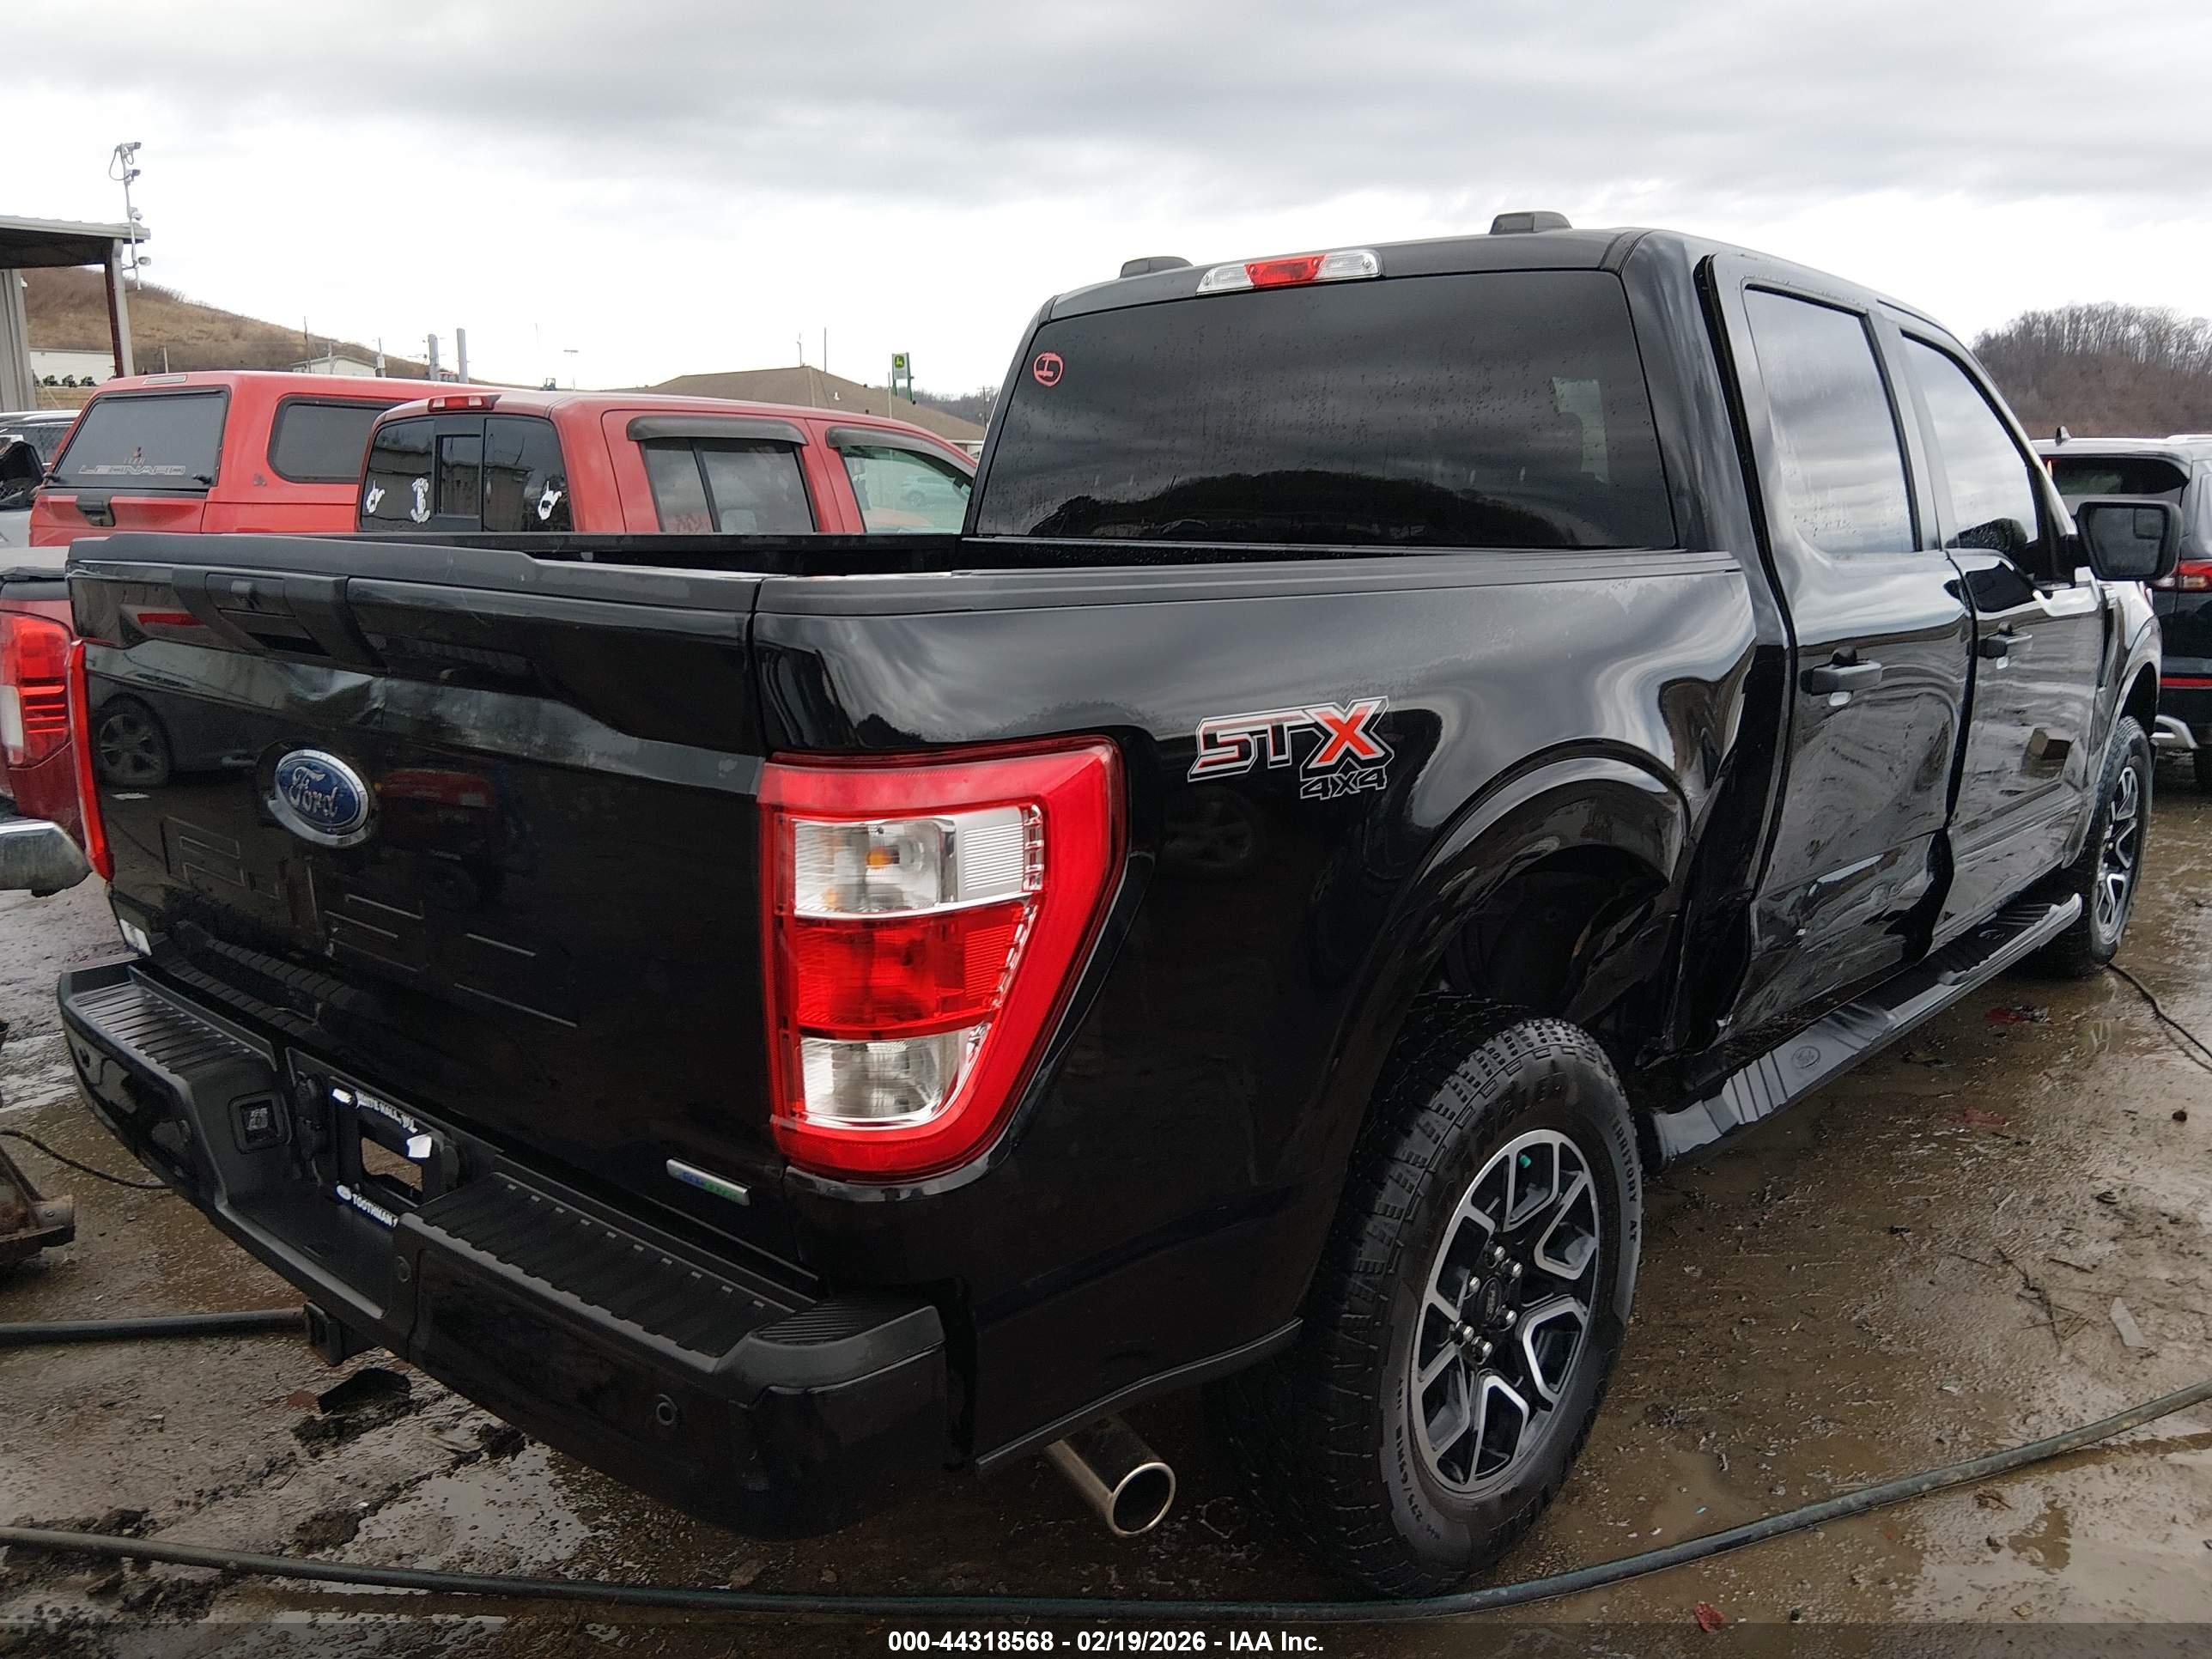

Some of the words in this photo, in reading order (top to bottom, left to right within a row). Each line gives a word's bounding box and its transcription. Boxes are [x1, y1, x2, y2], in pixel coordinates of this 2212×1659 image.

[78, 465, 186, 476] LEONARD
[1188, 696, 1395, 782] STX
[289, 766, 339, 817] Ford
